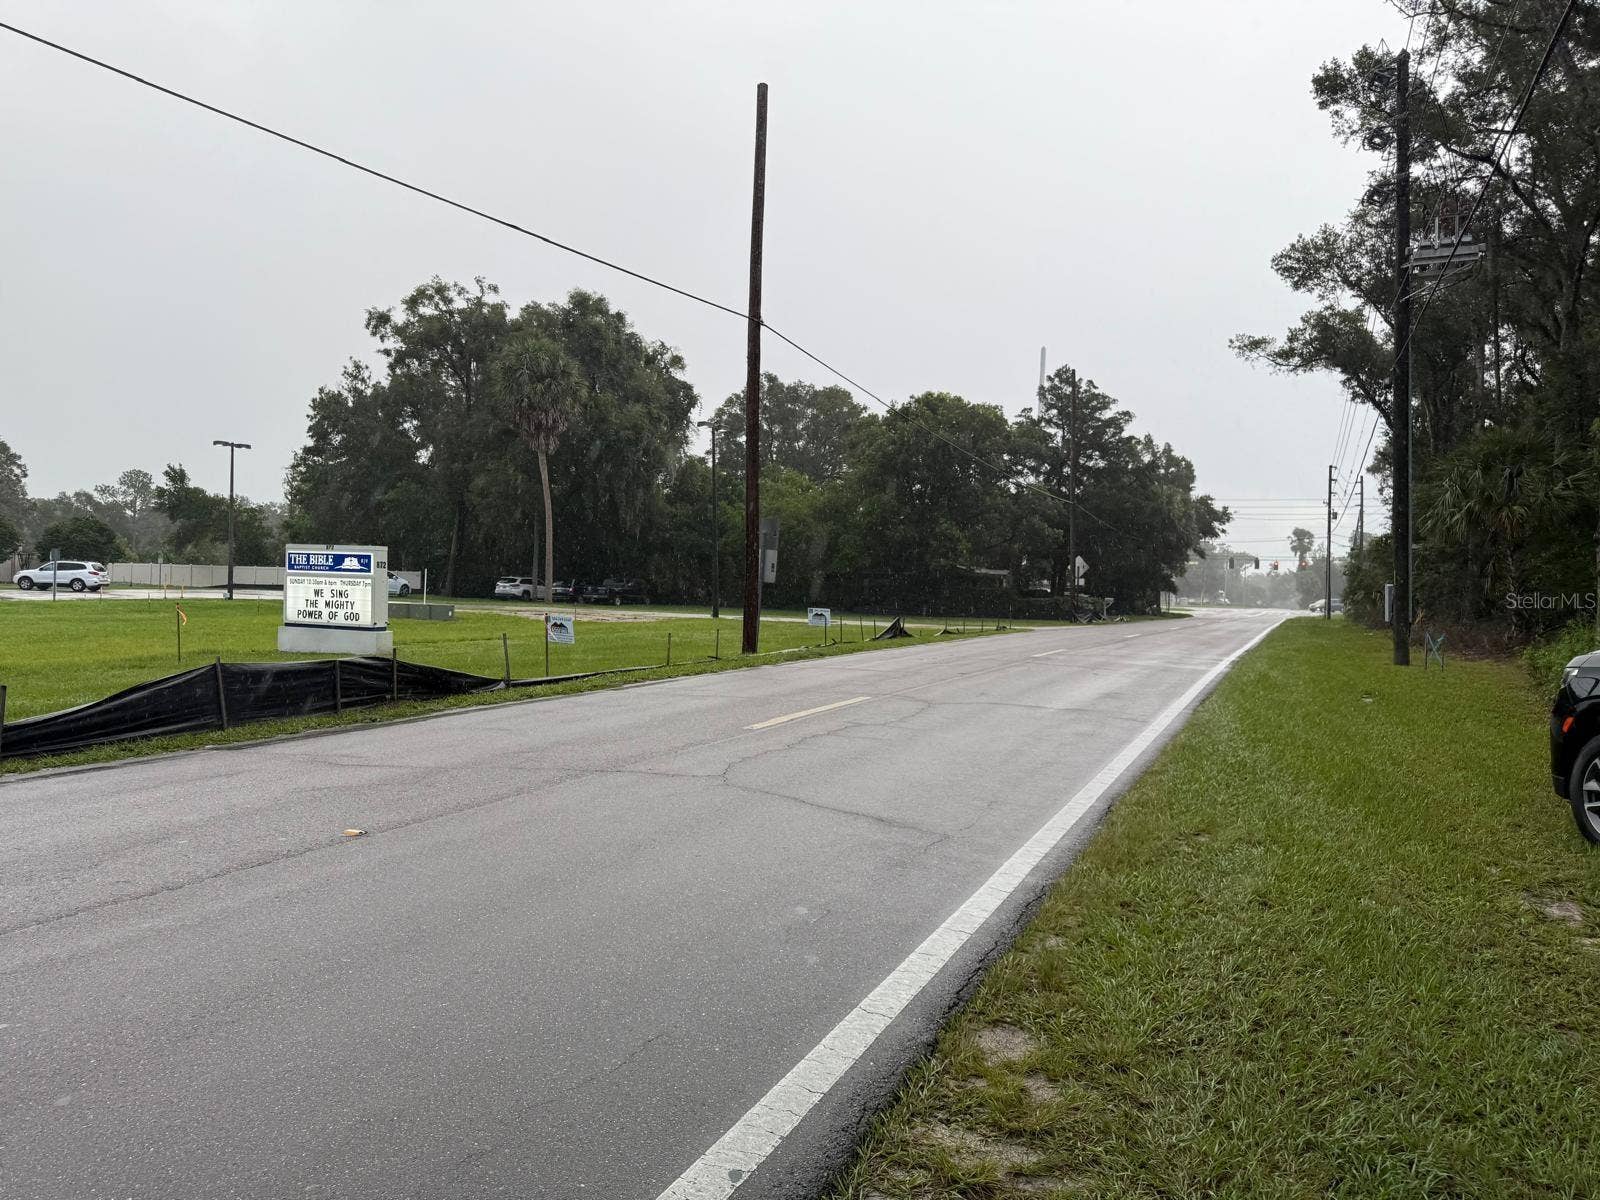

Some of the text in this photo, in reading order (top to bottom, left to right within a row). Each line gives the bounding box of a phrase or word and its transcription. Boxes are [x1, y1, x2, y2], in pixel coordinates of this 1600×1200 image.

[290, 554, 334, 566] THE BIBLE
[376, 561, 386, 569] 872
[314, 588, 348, 598] WE SING
[305, 599, 355, 610] THE MIGHTY
[297, 610, 360, 621] POWER OF GOD
